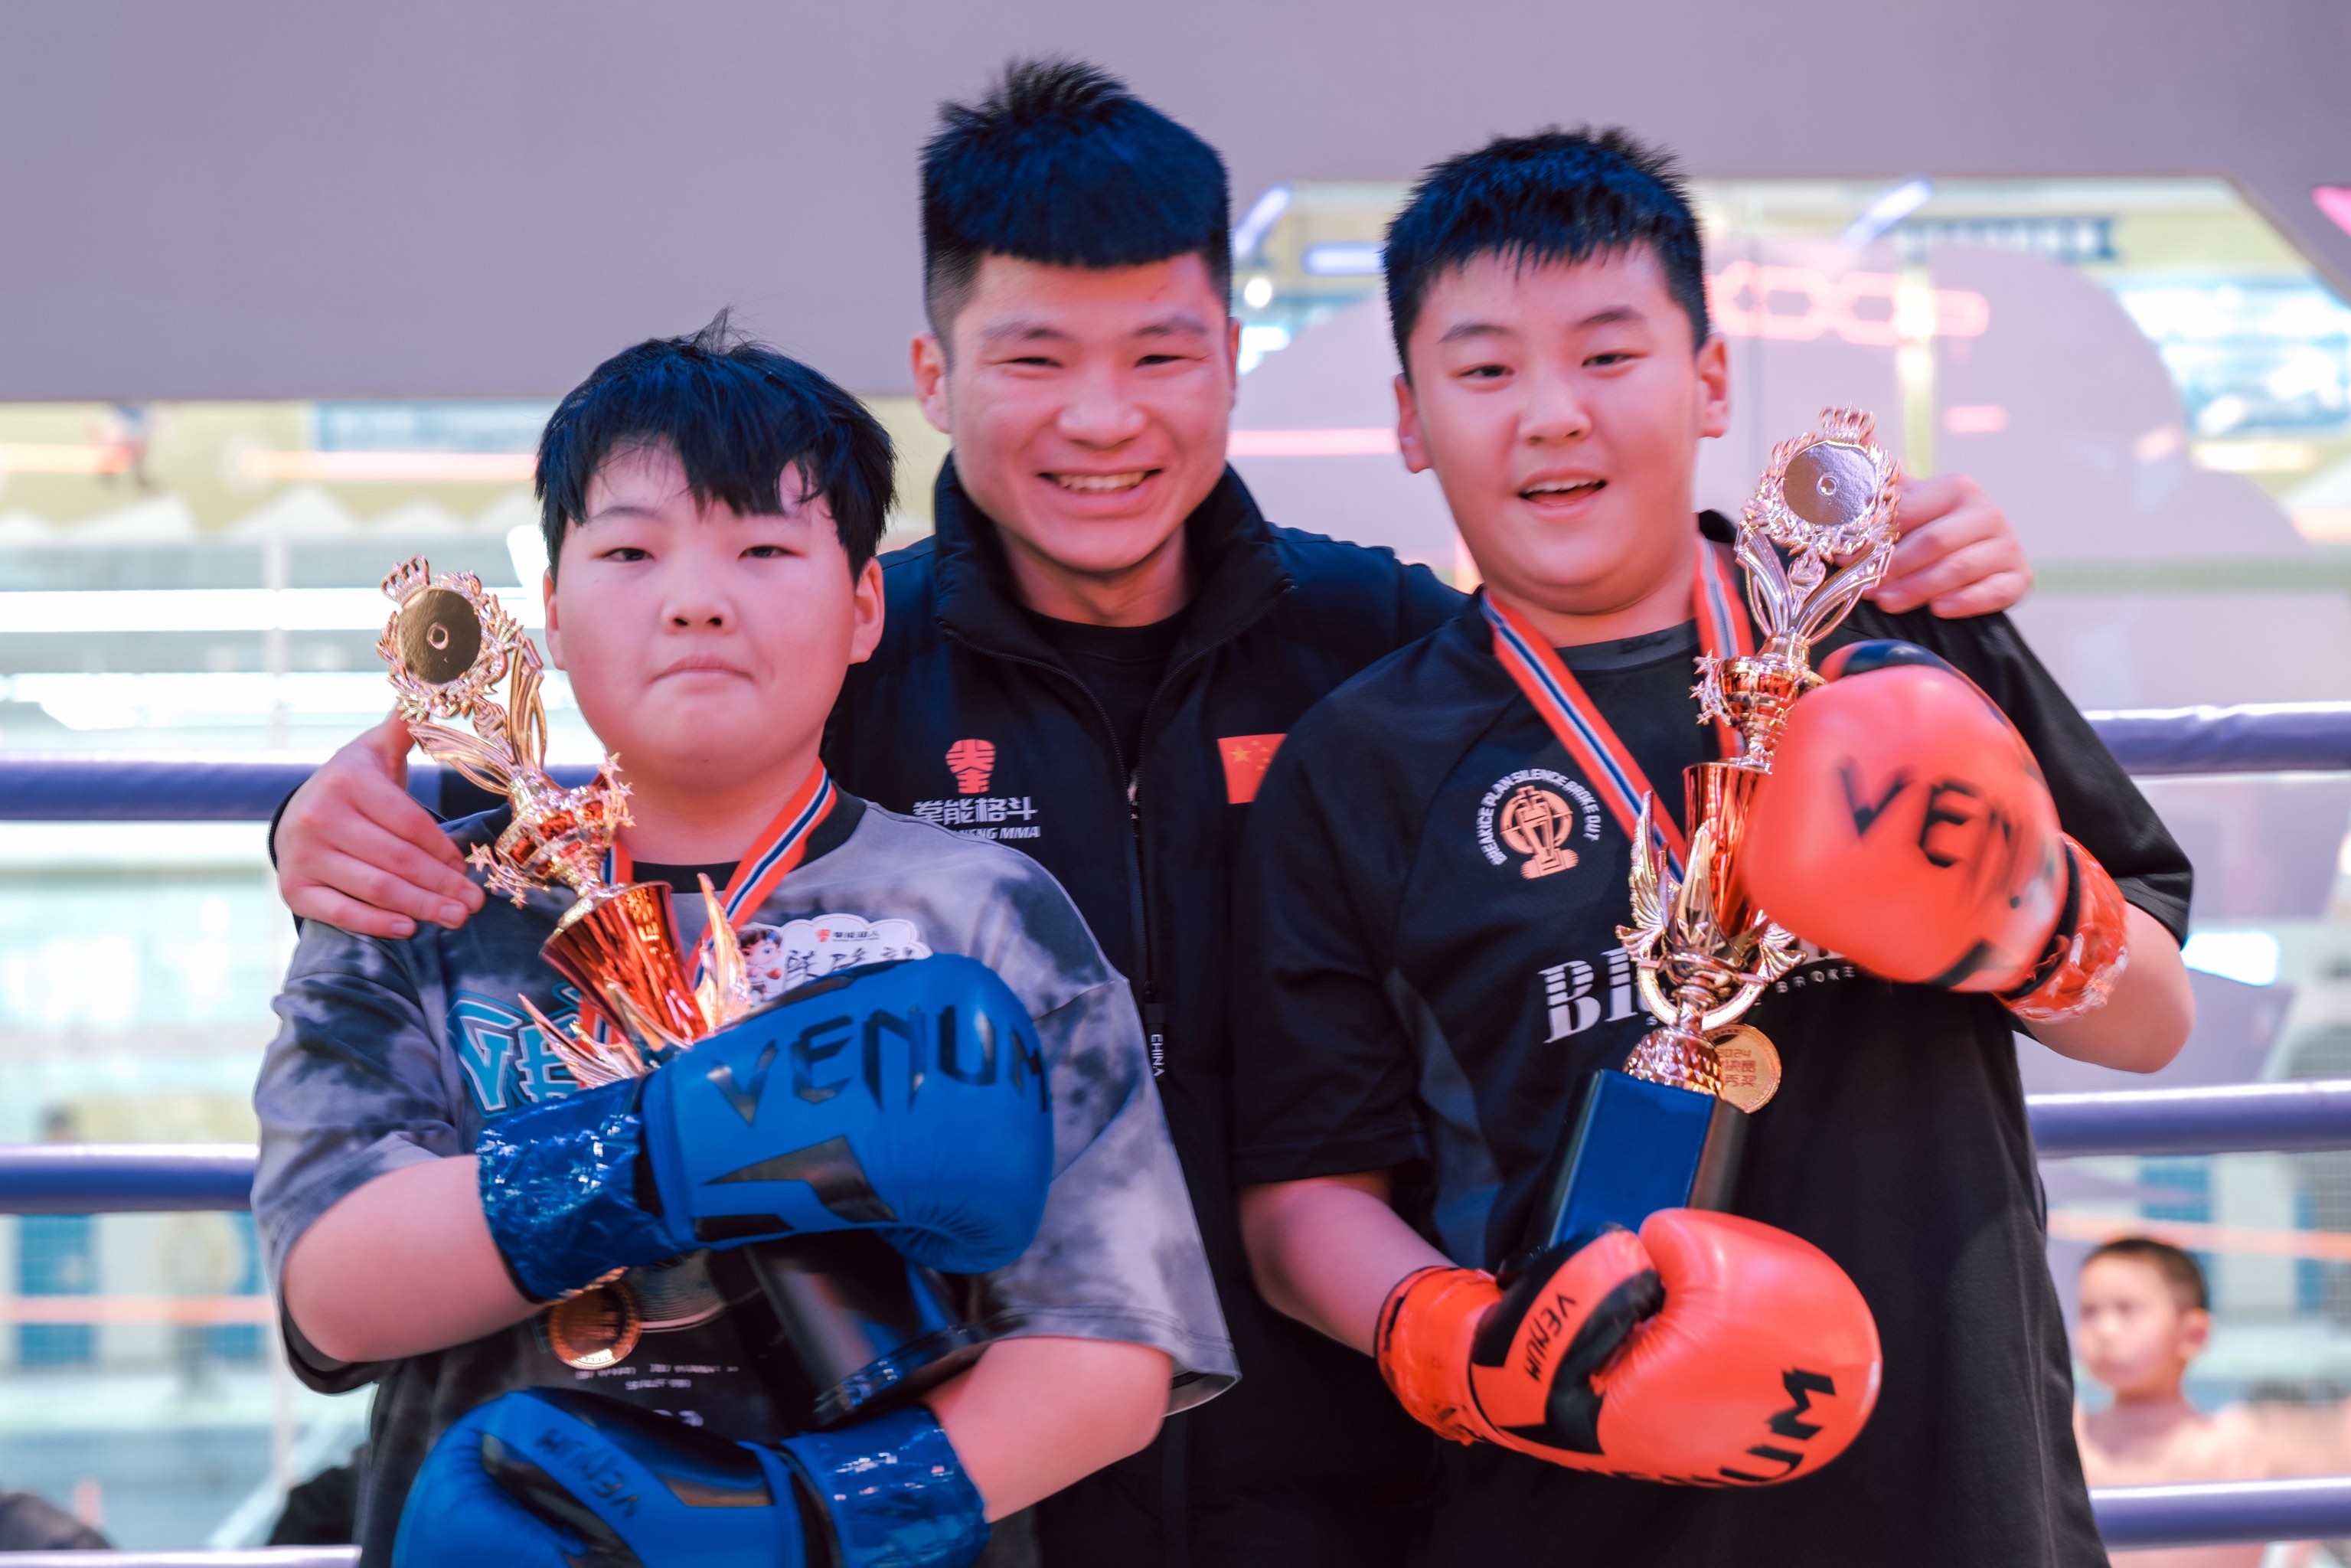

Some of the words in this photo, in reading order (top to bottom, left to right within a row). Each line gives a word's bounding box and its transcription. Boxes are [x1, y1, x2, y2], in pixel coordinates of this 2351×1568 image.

[913, 795, 1039, 826] 拳能格斗
[1481, 775, 1515, 808] PLAN
[1509, 768, 1569, 788] SILENCE
[1560, 780, 1600, 815] BROKE
[1582, 815, 1602, 841] OUT
[999, 825, 1041, 840] MMA
[1775, 965, 1856, 994] BROKE
[706, 1004, 1048, 1127] VENUM
[1523, 1292, 1577, 1382] VENUM
